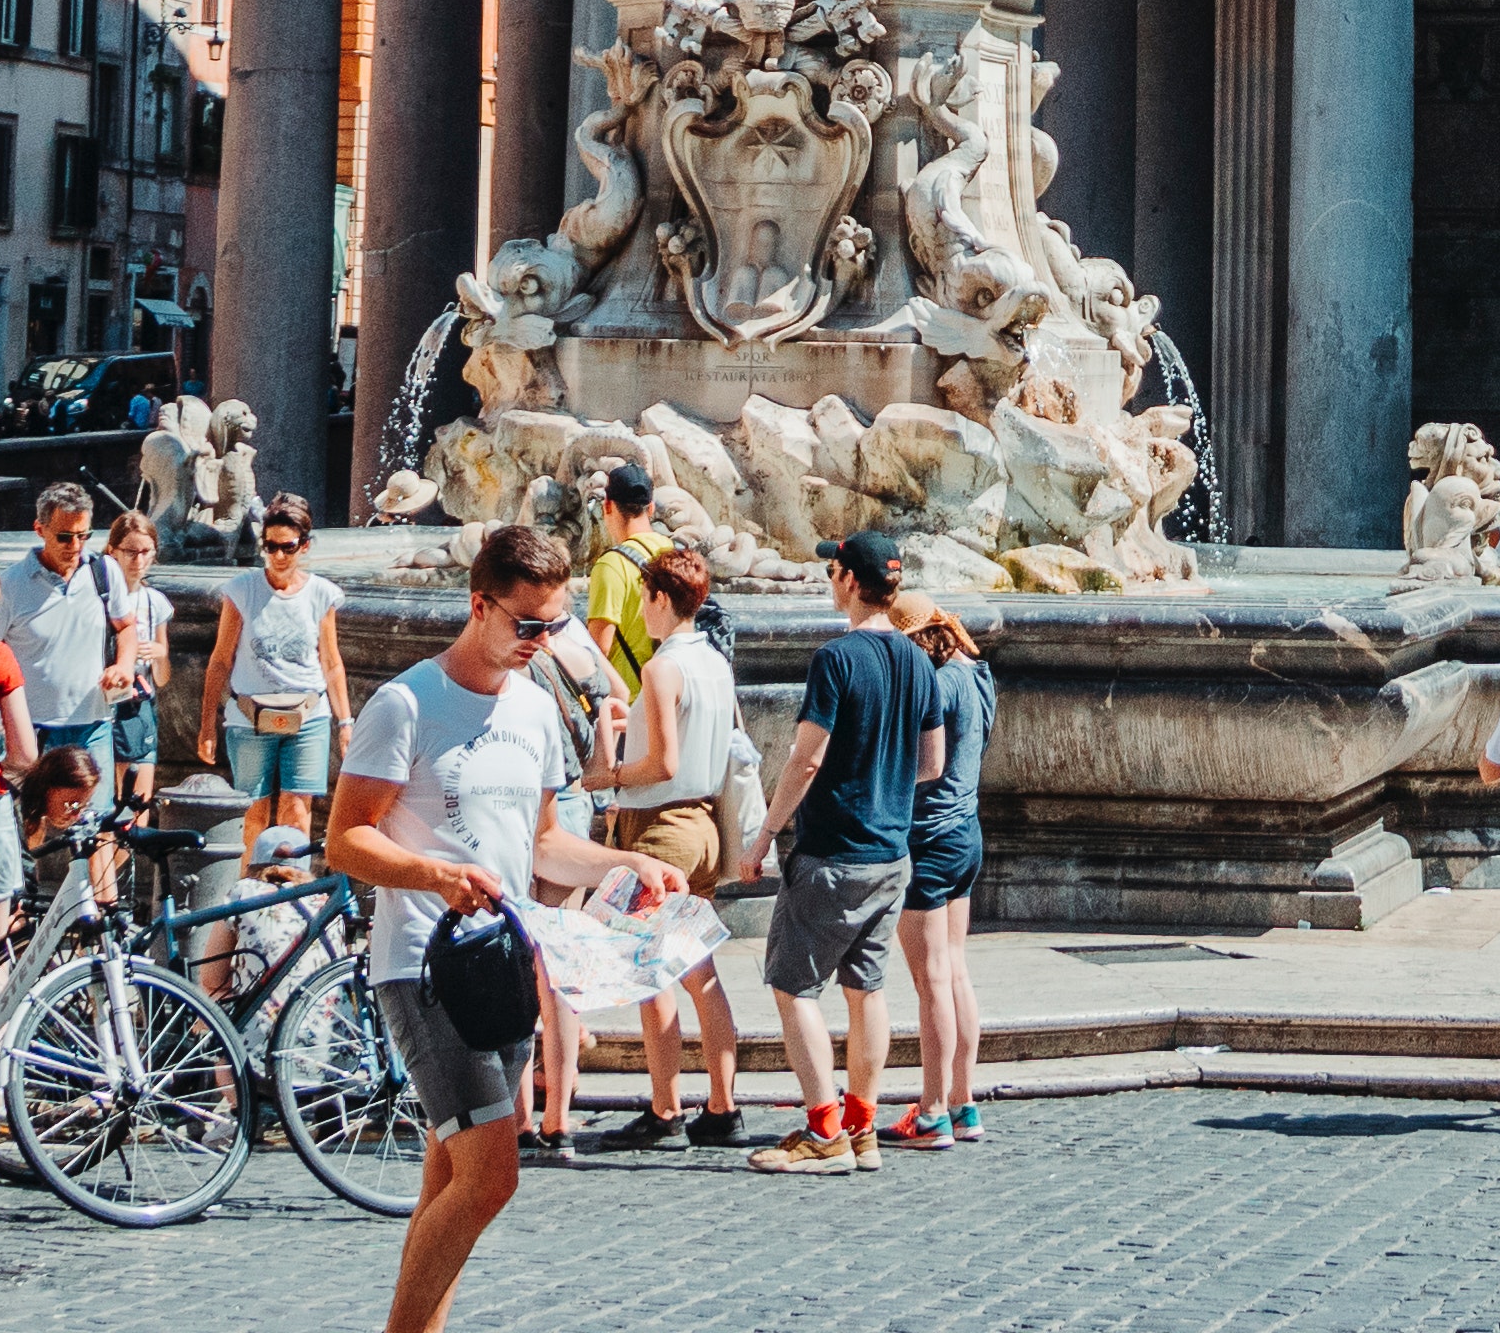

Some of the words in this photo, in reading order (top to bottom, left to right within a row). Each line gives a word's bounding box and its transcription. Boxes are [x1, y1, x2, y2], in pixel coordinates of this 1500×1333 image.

[444, 769, 462, 810] DENIM
[502, 730, 540, 764] DIVISION
[470, 785, 503, 797] ALWAYS
[503, 785, 515, 797] ON
